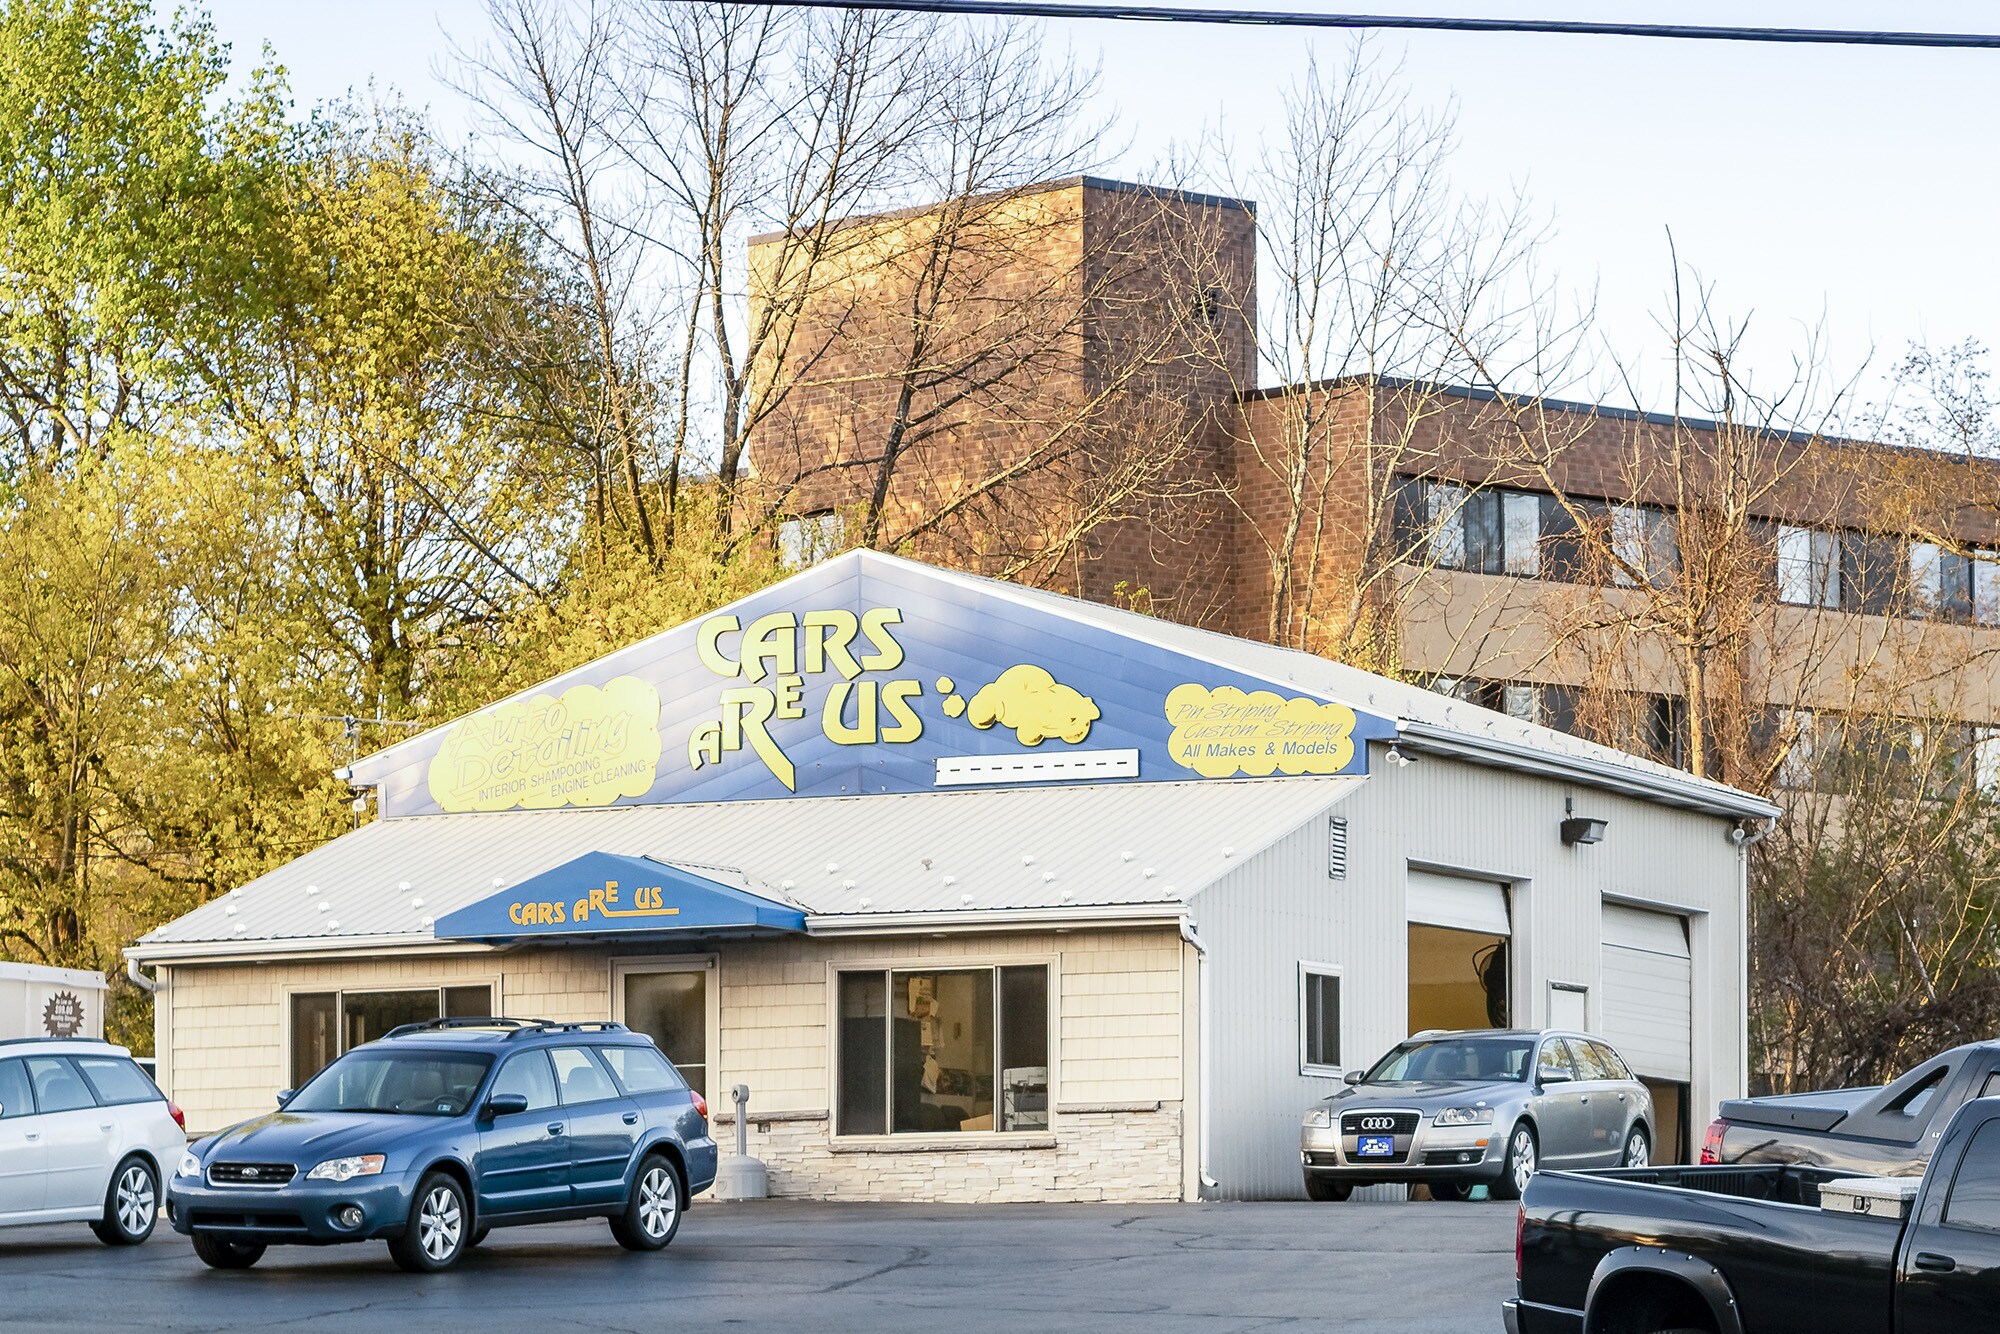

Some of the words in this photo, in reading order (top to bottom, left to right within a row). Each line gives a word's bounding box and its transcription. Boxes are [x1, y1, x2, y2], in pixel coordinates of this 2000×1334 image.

[696, 607, 904, 684] CARS
[449, 702, 568, 758] Auto
[1175, 704, 1204, 719] Pin
[1204, 702, 1281, 722] Striping
[1183, 722, 1259, 739] Custom
[1265, 720, 1344, 741] Striping
[449, 709, 633, 798] Detailing
[687, 675, 805, 793] ARE
[822, 679, 922, 745] US
[1182, 743, 1200, 758] All
[1205, 743, 1256, 757] Makes
[1264, 742, 1275, 756] &
[1282, 741, 1338, 755] Models
[478, 780, 527, 802] INTERIOR
[530, 757, 601, 788] SHAMPOOING
[551, 778, 589, 798] ENGINE
[593, 759, 646, 785] CLEANING
[509, 902, 566, 926] CARS
[634, 887, 663, 909] US
